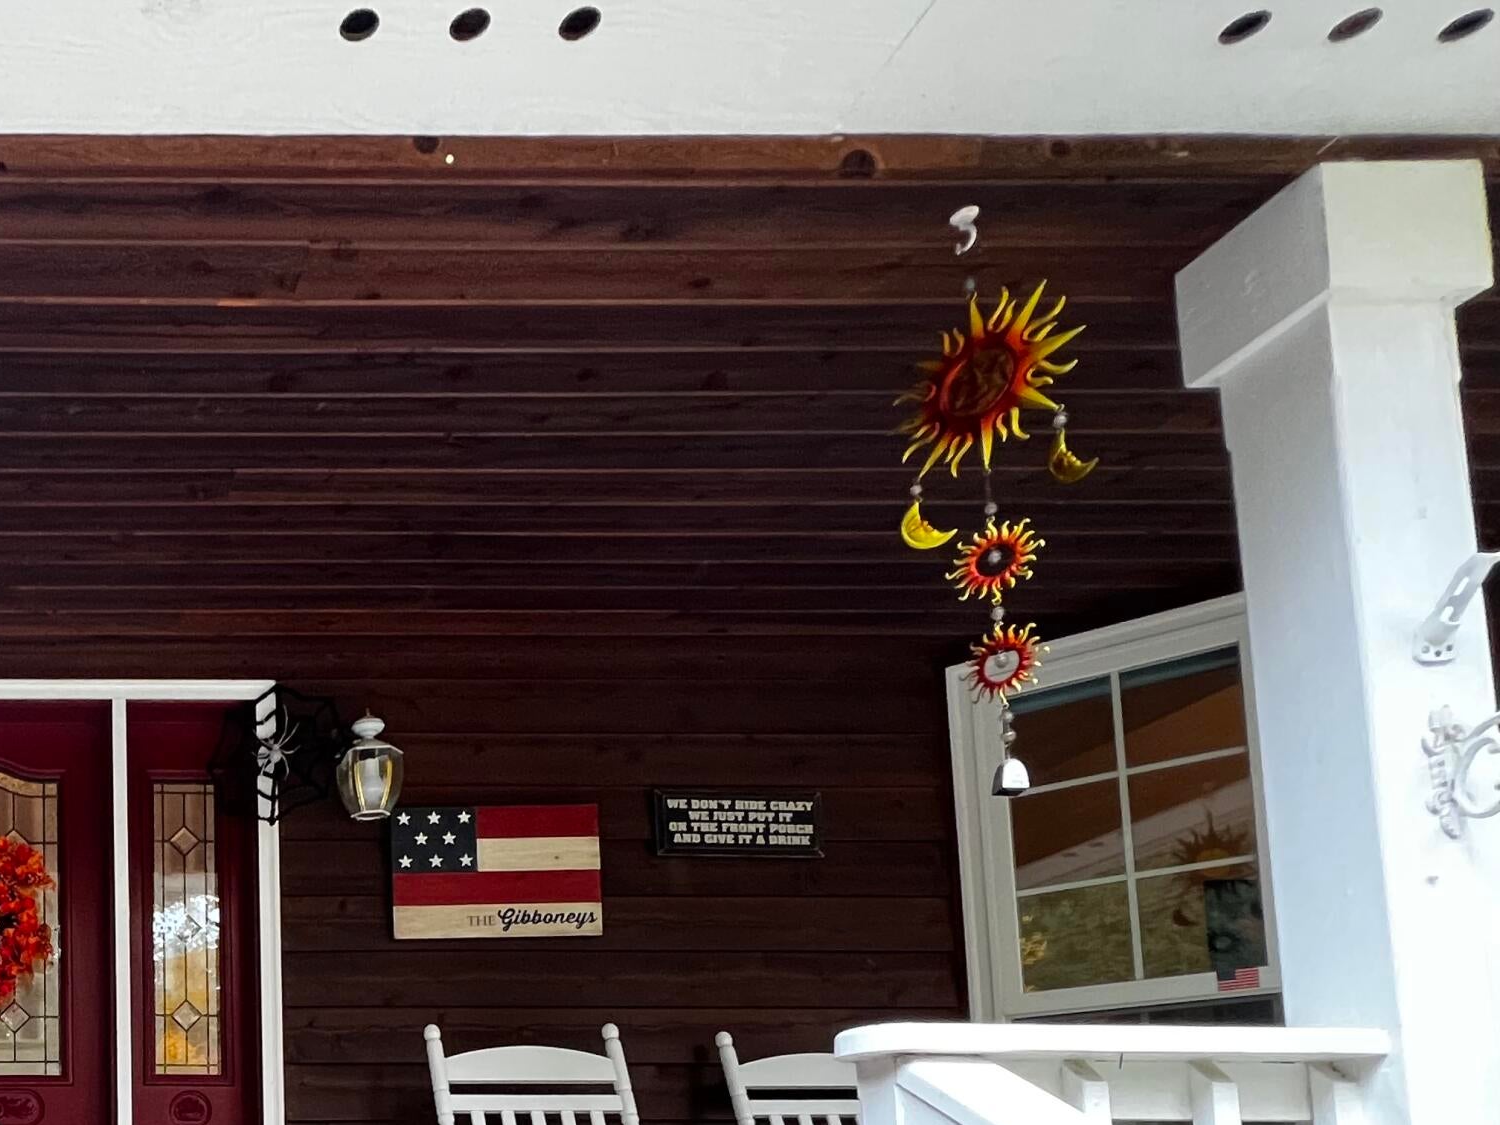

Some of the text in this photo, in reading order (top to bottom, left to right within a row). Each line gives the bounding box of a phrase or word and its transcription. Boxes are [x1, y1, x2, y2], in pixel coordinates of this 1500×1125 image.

[667, 799, 813, 811] WE DON'T HIDE CRAZY
[688, 811, 793, 822] WE JUST PUT IT
[669, 822, 813, 834] ON THE FRONT PORCH
[673, 834, 810, 845] AND GIVE IT A DRINK
[467, 908, 598, 931] THE Gibboneys
